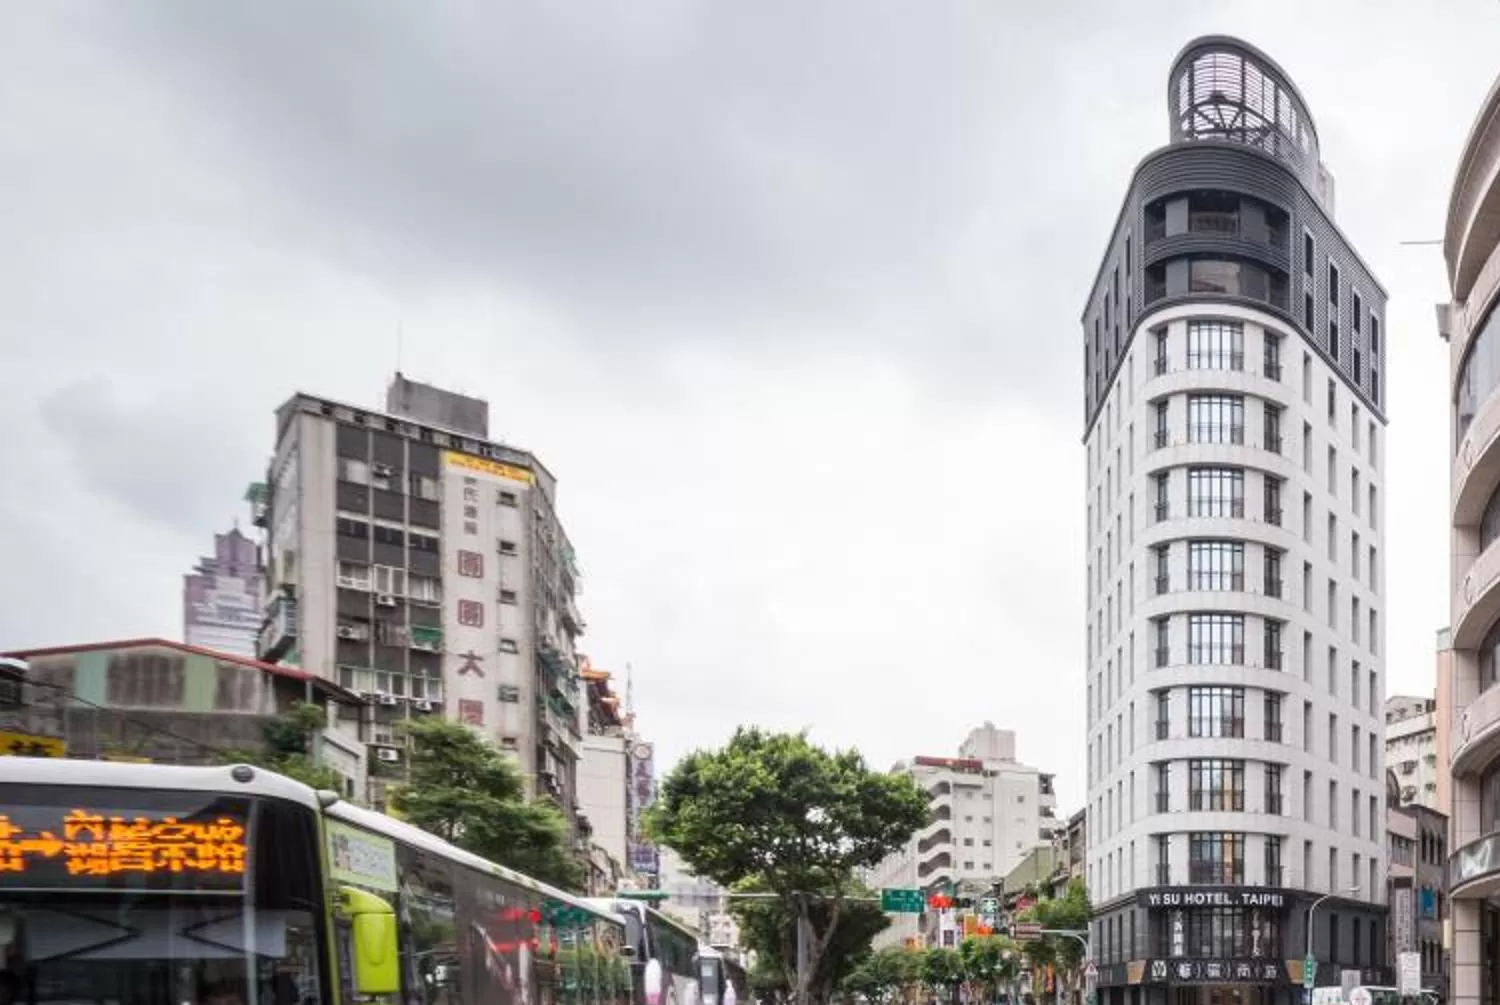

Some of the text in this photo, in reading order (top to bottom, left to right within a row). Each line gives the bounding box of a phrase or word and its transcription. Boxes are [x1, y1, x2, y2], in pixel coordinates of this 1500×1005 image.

[1163, 893, 1180, 905] SU
[1184, 892, 1232, 905] HOTEL
[1242, 893, 1283, 906] TAIPEI
